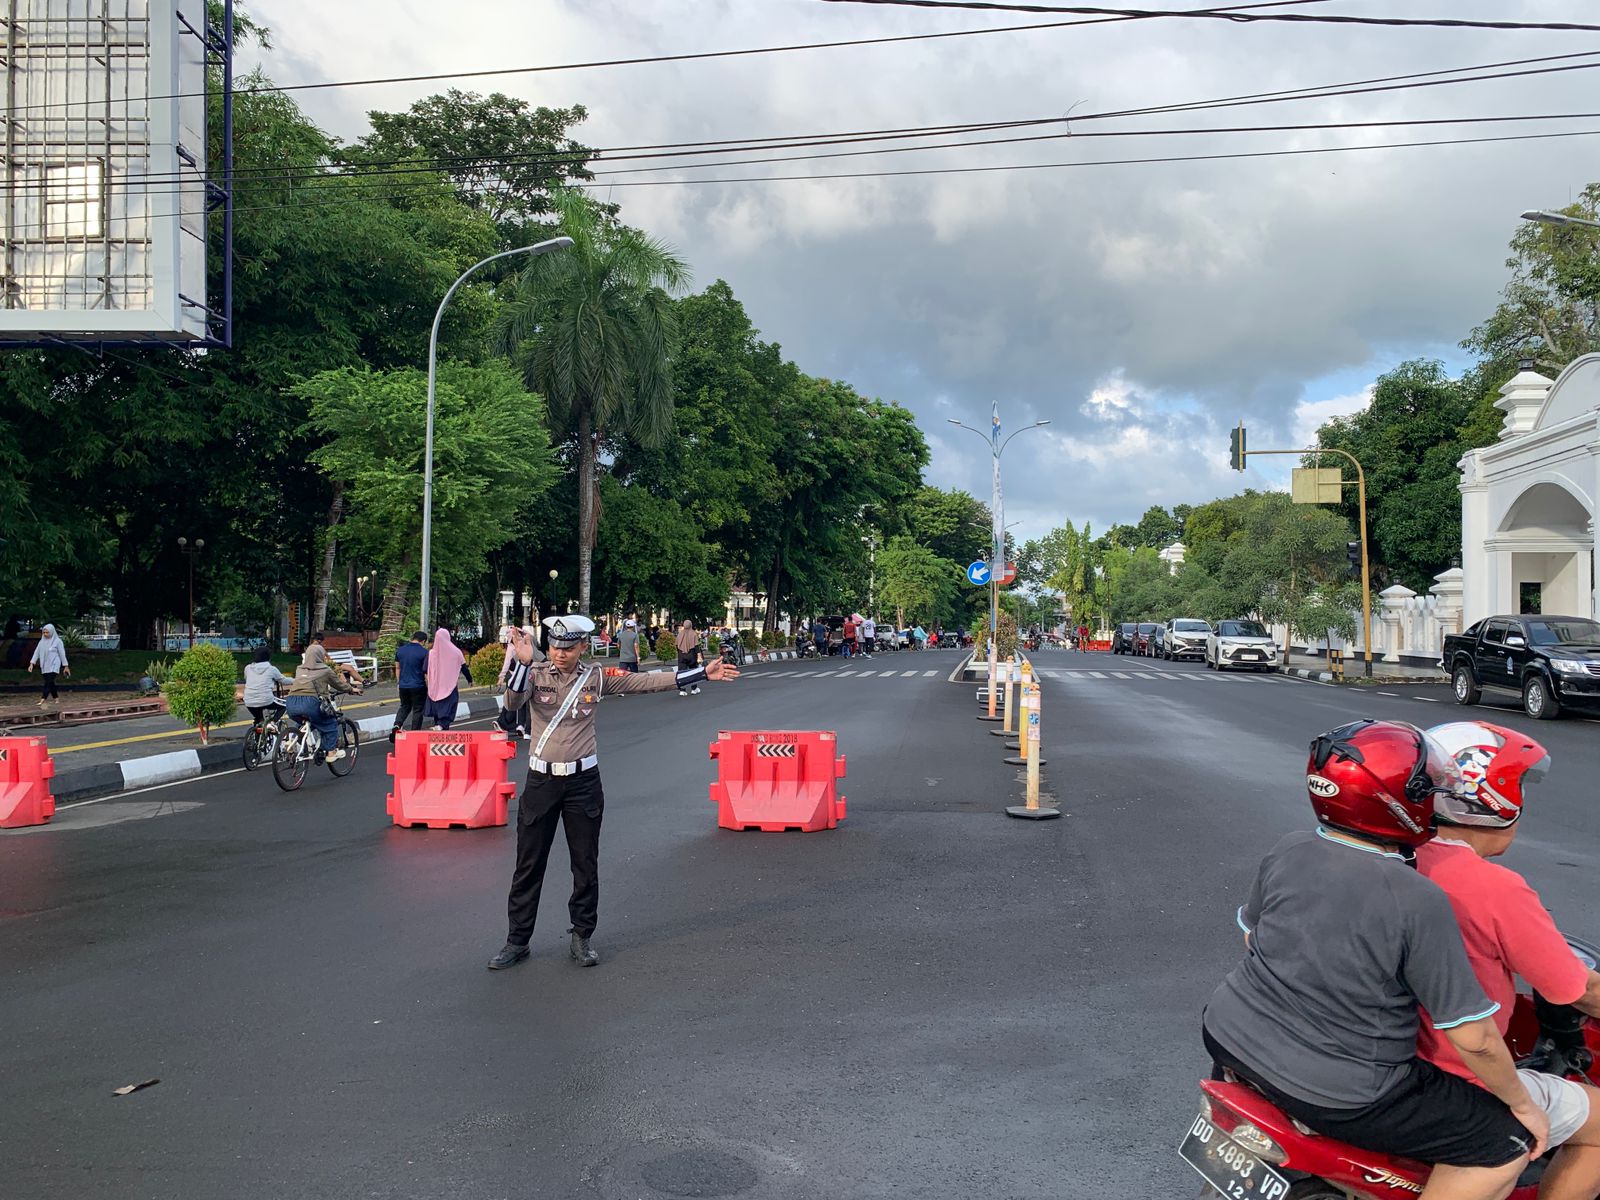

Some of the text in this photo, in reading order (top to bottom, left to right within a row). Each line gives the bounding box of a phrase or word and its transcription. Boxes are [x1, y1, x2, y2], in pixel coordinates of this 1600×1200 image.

[459, 733, 473, 743] 2018
[783, 734, 798, 744] 2018
[1308, 778, 1332, 793] NHK
[1192, 1117, 1283, 1200] DD 4883 VP
